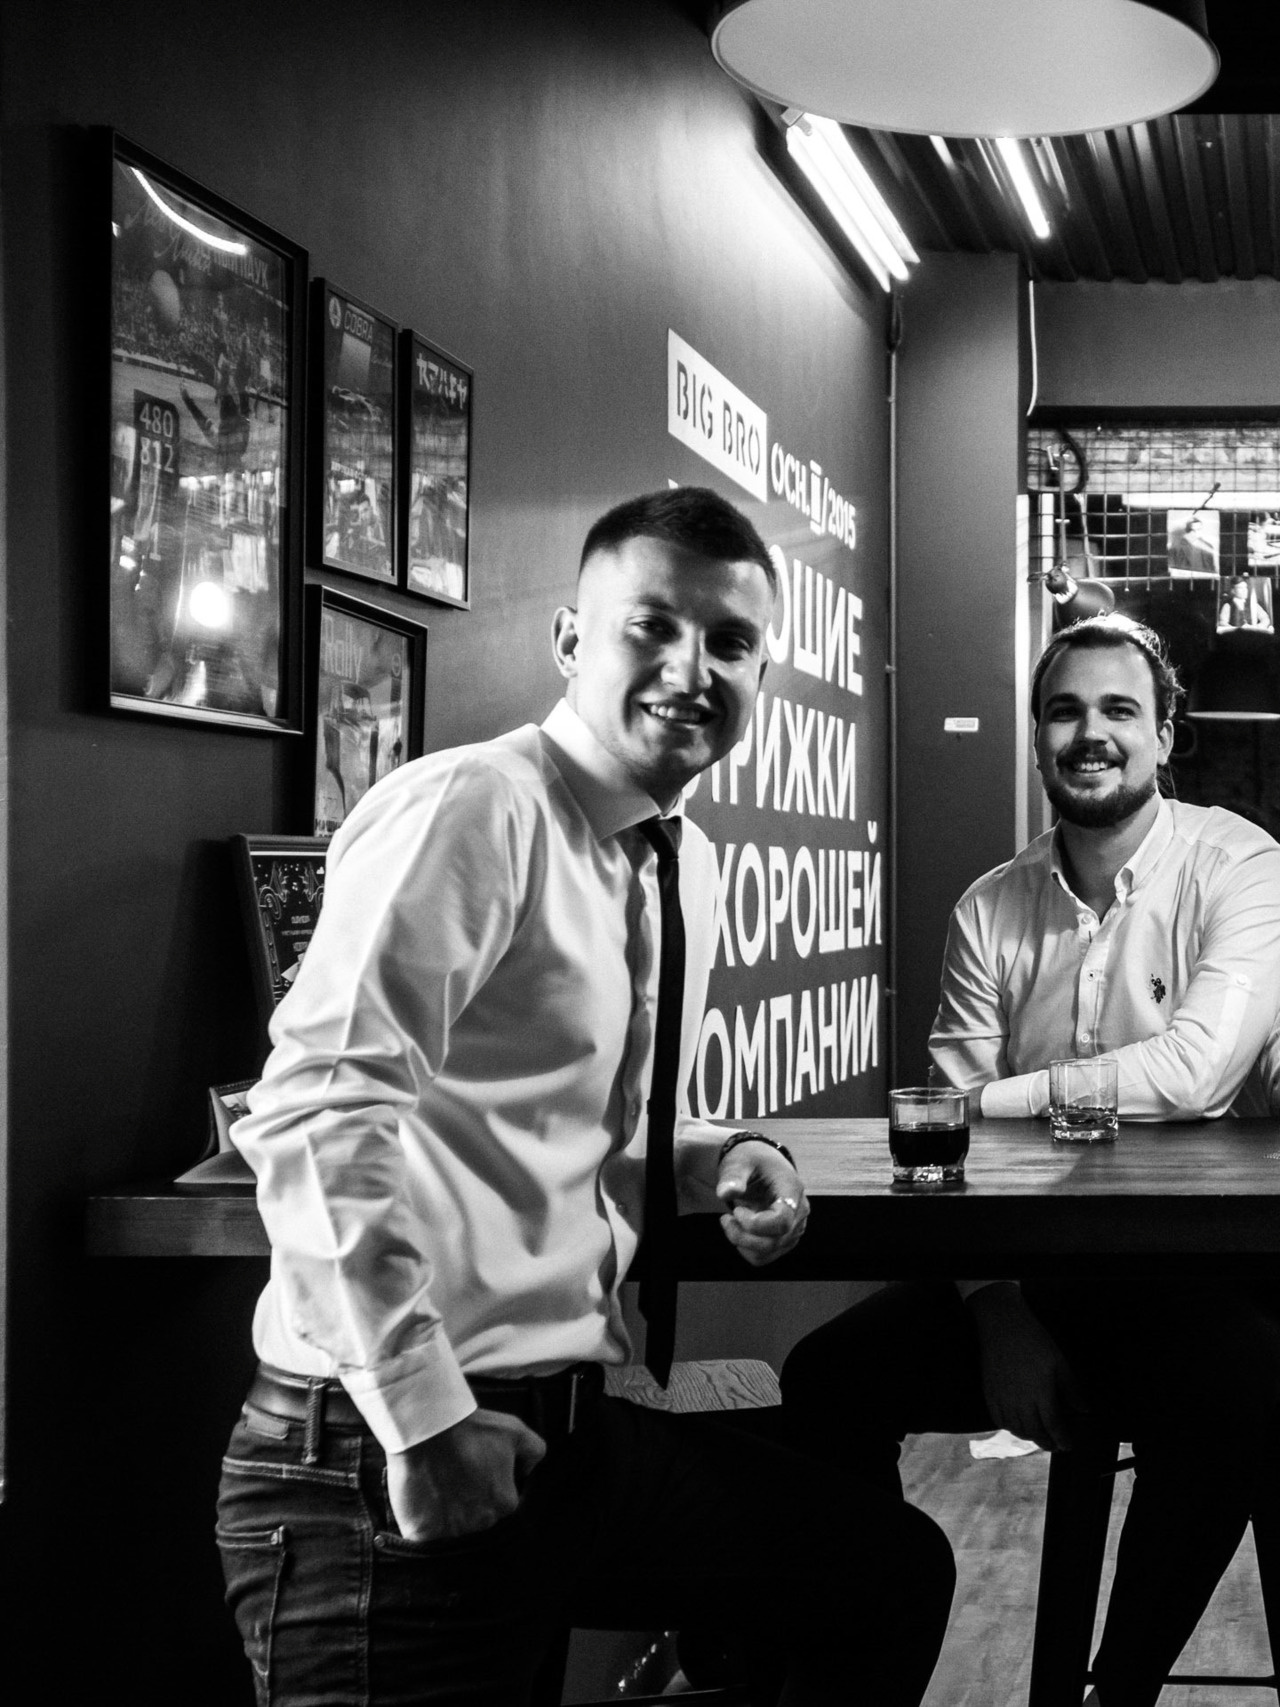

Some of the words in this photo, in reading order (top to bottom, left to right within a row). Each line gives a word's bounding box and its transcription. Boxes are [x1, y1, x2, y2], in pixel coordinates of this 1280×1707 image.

[343, 310, 374, 343] COBRA
[139, 402, 174, 438] 480
[140, 436, 175, 474] 812
[677, 360, 713, 440] BIG
[723, 399, 761, 476] BRO
[765, 543, 863, 697] ОШИЕ
[708, 820, 882, 968] ХОРОШЕЙ
